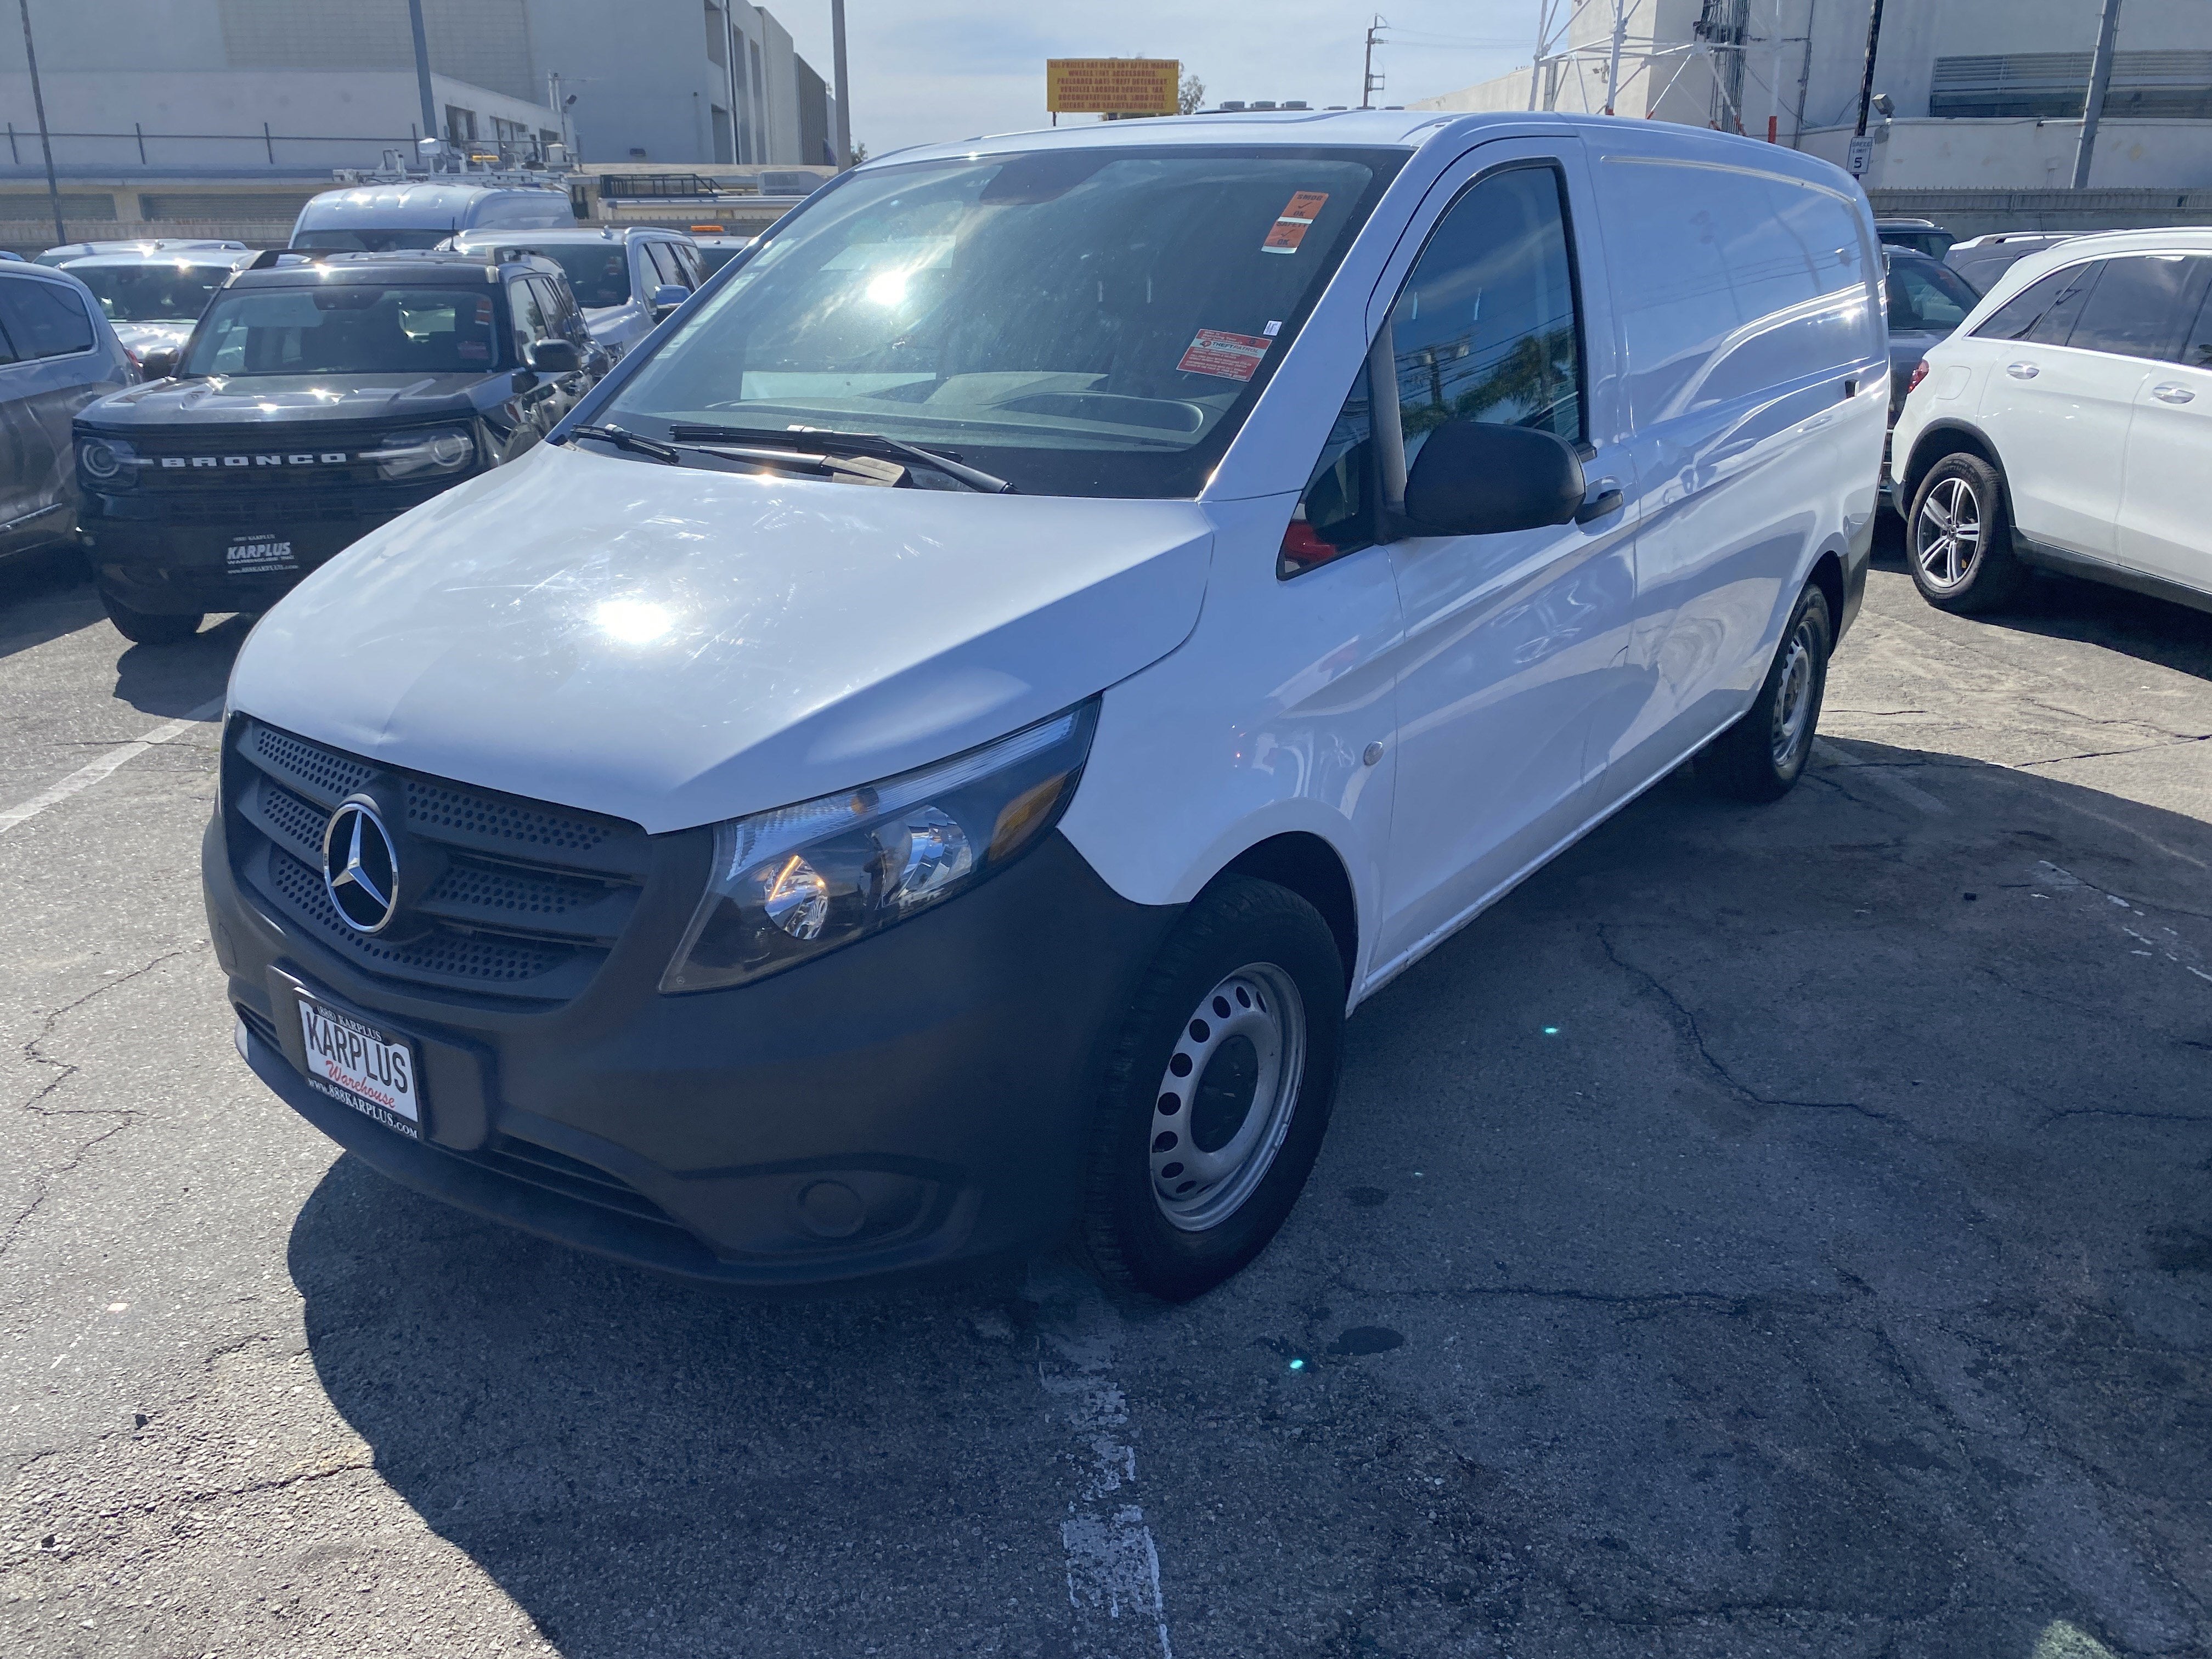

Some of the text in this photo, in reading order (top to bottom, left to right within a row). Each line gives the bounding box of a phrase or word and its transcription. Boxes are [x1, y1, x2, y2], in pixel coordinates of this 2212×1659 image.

[1854, 157, 1863, 168] 5
[161, 453, 347, 467] BRONCO
[227, 541, 291, 560] KARPLUS
[337, 1014, 382, 1042] KARPLUS
[306, 1011, 408, 1094] KARPLUS
[325, 1060, 396, 1109] Warehouse
